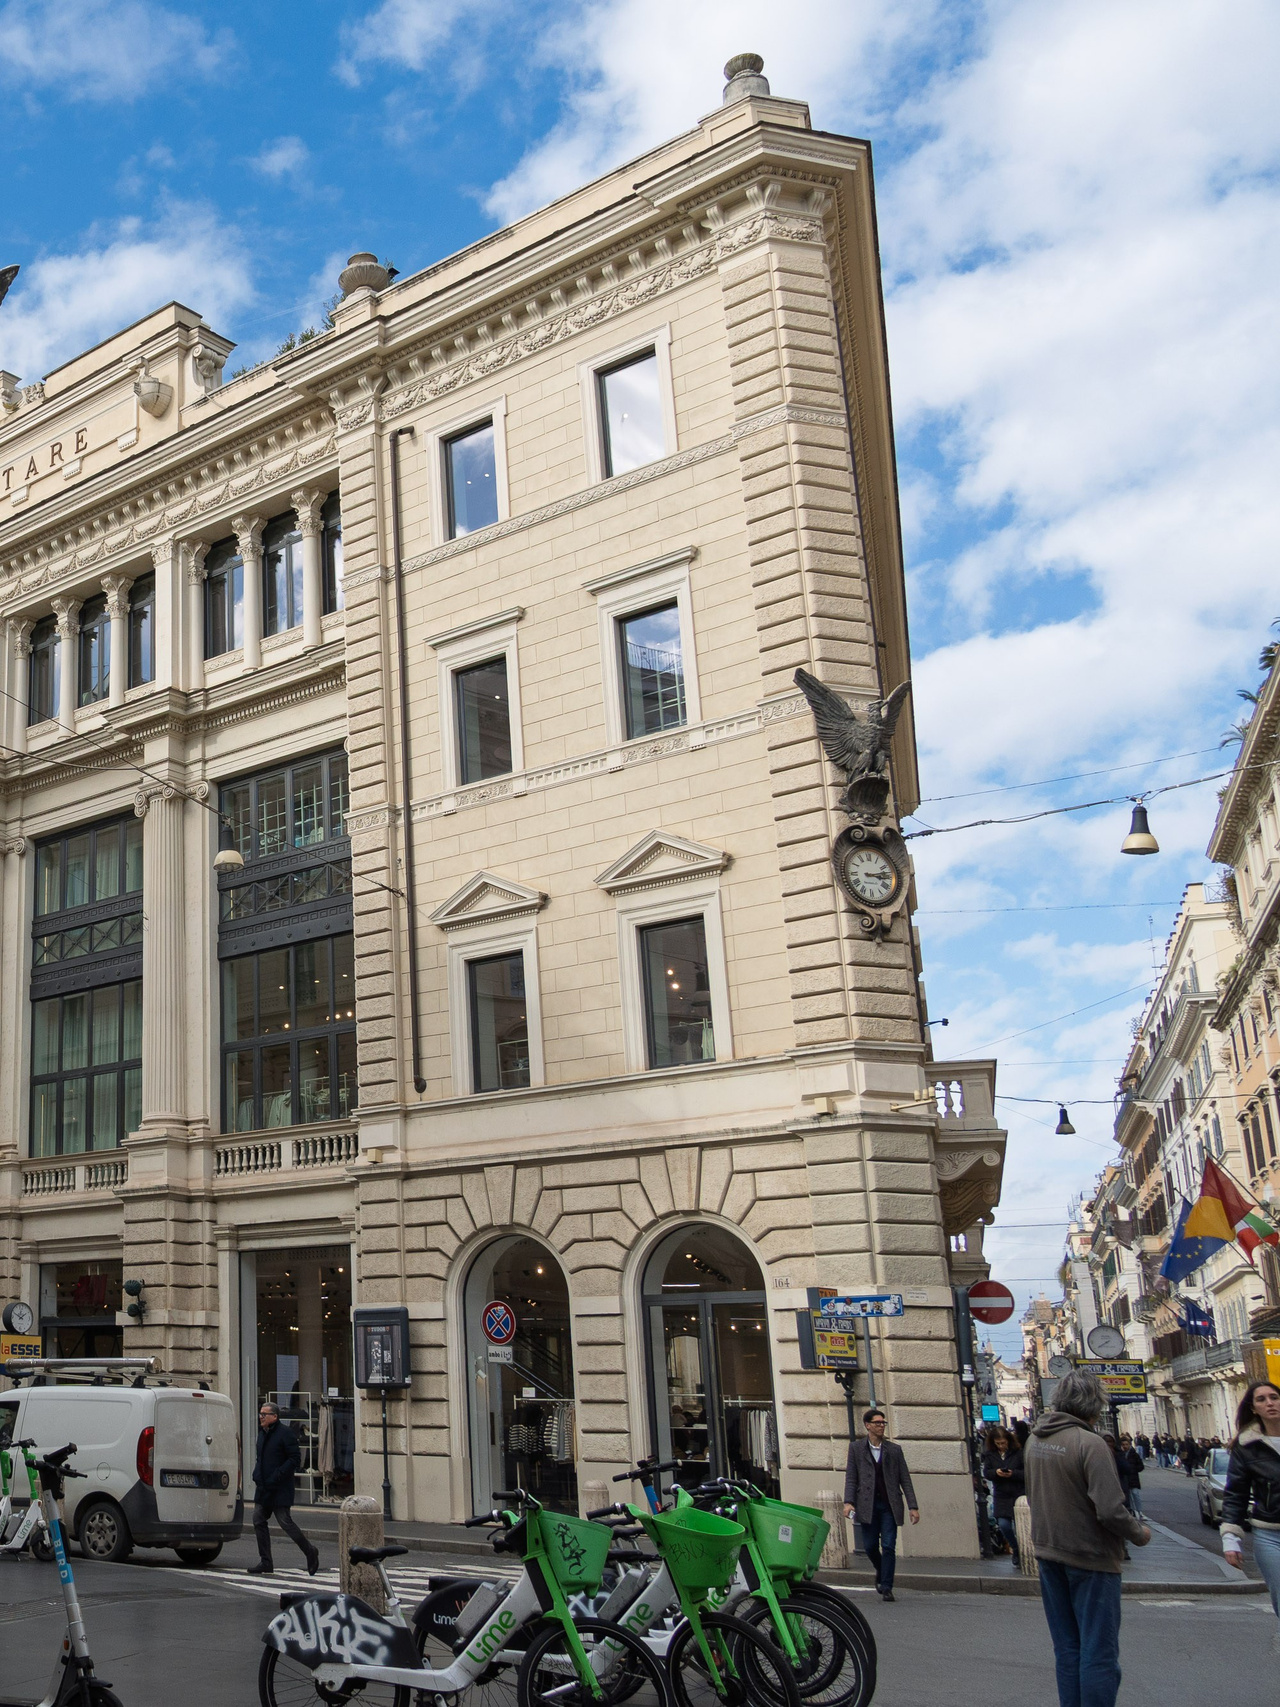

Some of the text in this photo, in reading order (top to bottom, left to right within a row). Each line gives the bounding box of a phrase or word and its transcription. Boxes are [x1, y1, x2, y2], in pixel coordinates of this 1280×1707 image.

[774, 1278, 790, 1288] 164
[17, 1519, 33, 1540] Lime
[54, 1537, 68, 1579] BIRD
[433, 1613, 459, 1626] Lime
[466, 1610, 517, 1665] Lime
